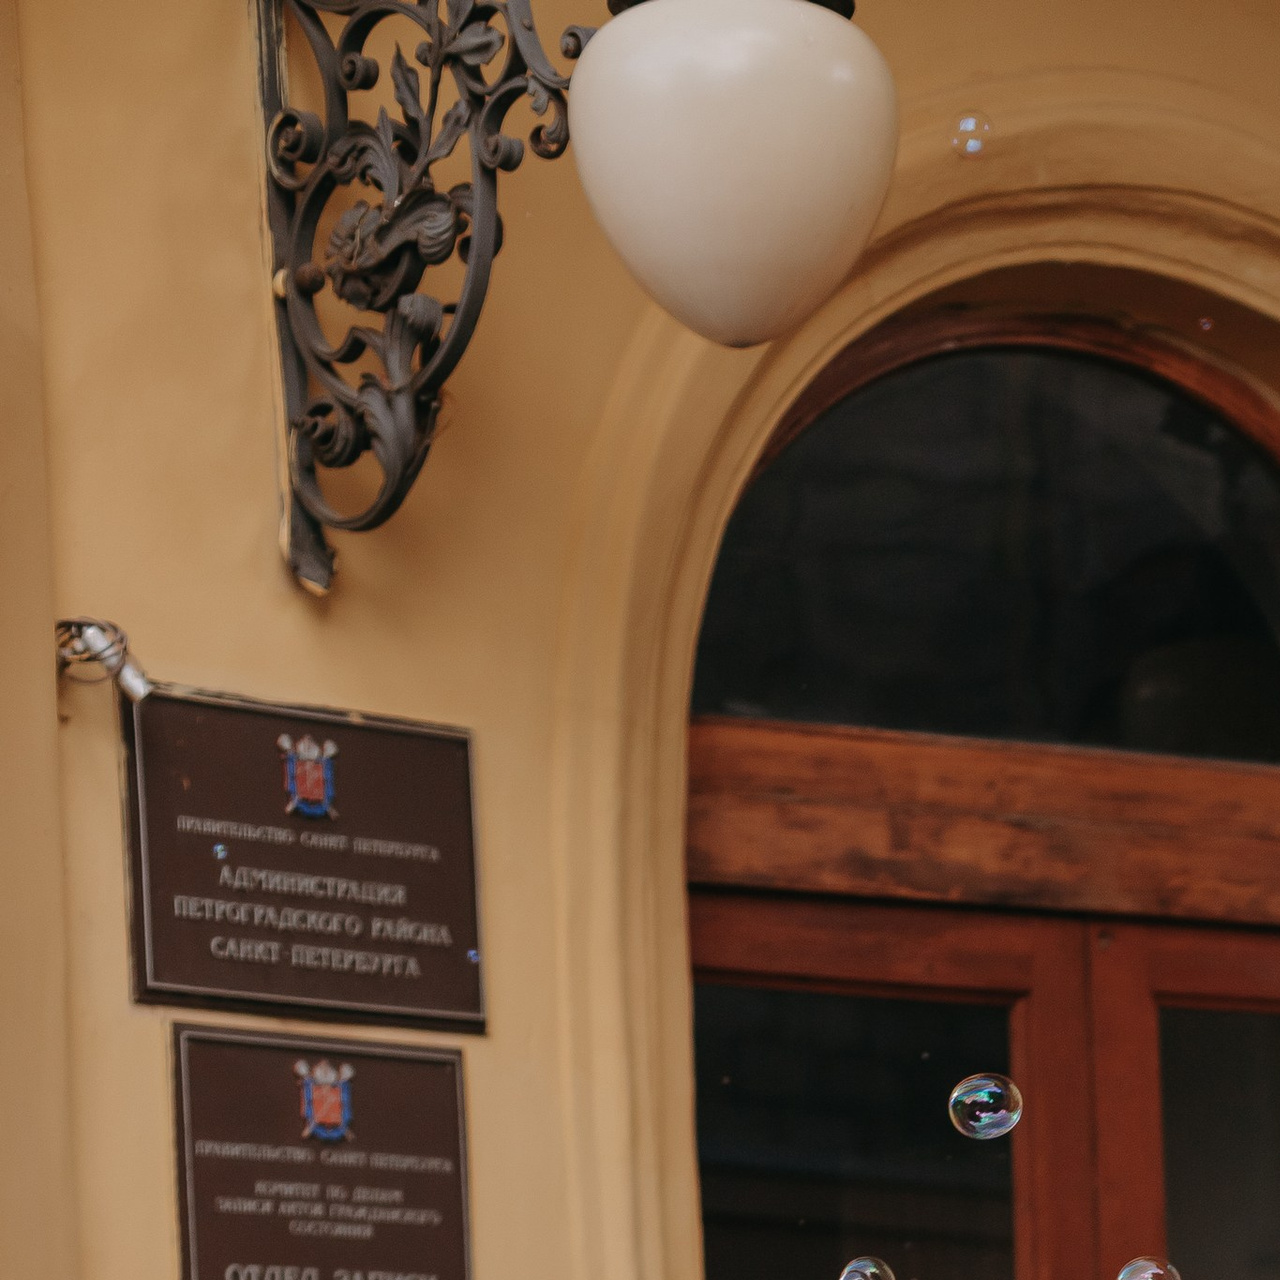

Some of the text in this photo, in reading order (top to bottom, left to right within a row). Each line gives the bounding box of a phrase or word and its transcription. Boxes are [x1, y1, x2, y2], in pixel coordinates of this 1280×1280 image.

[177, 815, 296, 845] ПРАВИТЕЛЬСТВО
[218, 864, 407, 906] АДМИНИСТРАЦИЯ
[173, 895, 453, 947] ПЕТРОГРАДСКОГО РАЙОНА
